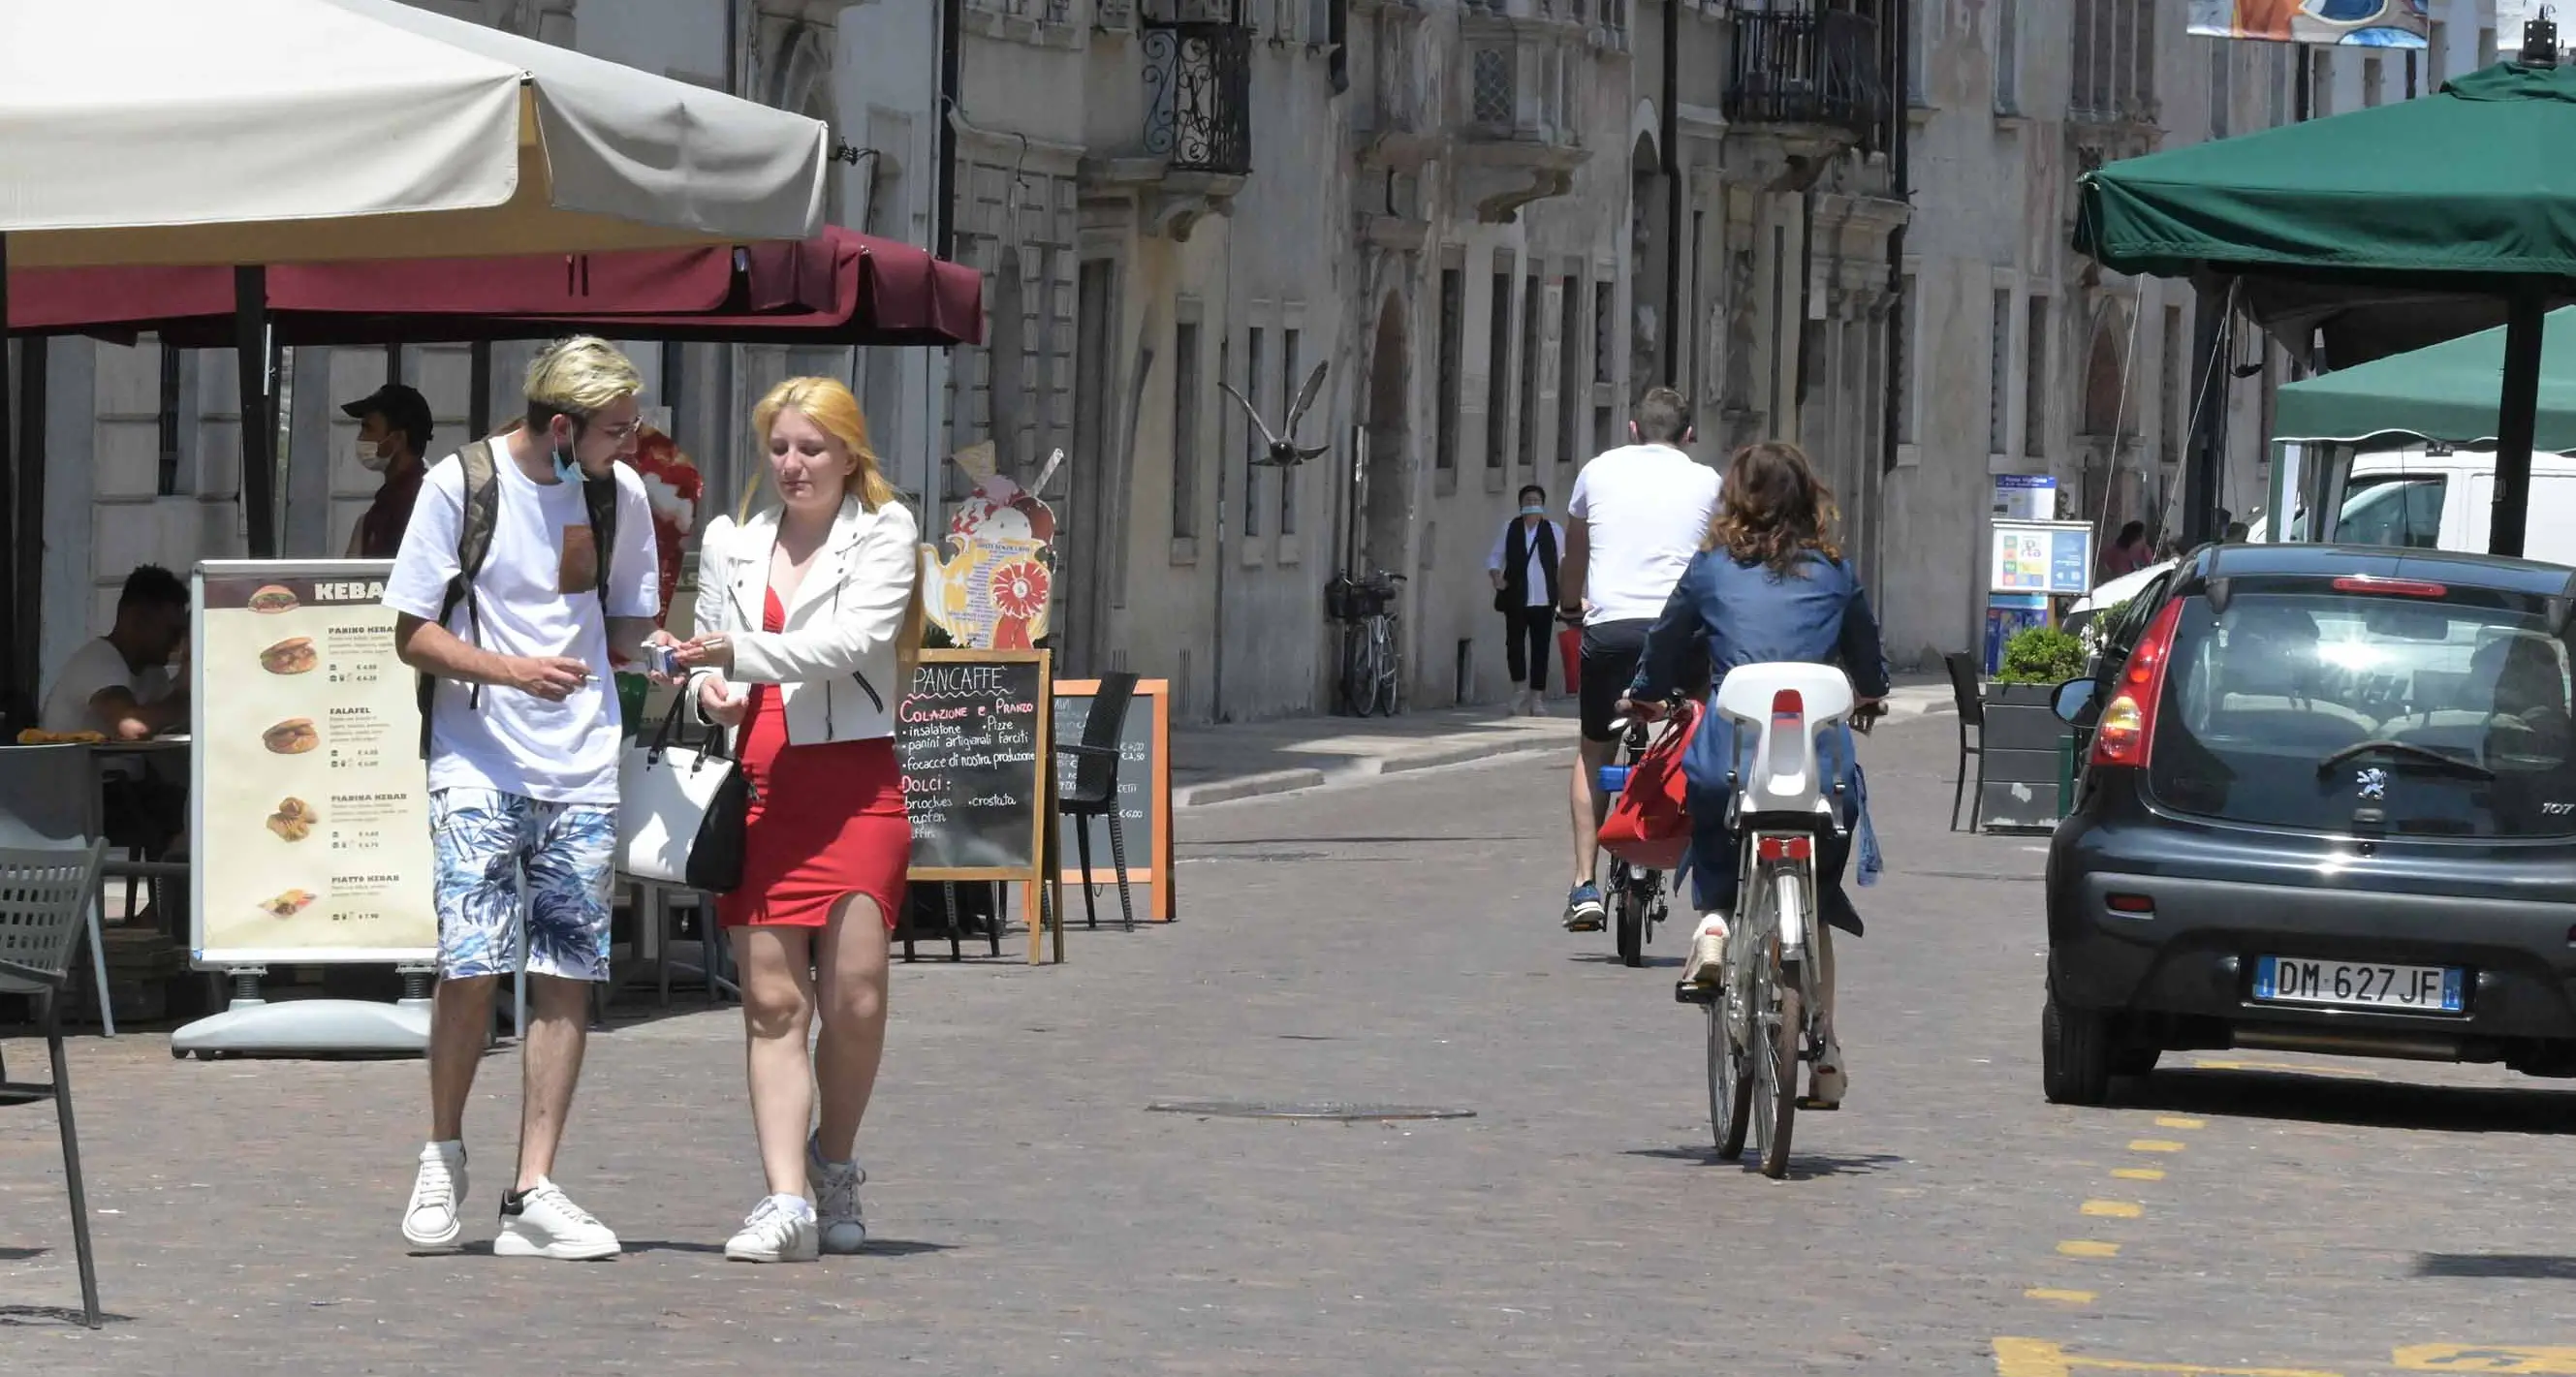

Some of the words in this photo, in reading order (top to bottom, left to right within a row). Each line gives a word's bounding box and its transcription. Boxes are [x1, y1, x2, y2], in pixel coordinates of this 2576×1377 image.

[315, 582, 385, 600] KEBA
[367, 625, 395, 634] KEBA
[900, 700, 968, 723] COLAZIONE
[977, 705, 987, 717] e
[995, 698, 1034, 715] PRANZO
[909, 723, 961, 736] insalatone
[908, 735, 940, 756] panini
[945, 734, 991, 751] artigianali
[949, 752, 959, 767] di
[960, 753, 992, 767] nostra
[992, 747, 1035, 770] produzione
[904, 795, 953, 810] brioches
[971, 793, 1017, 807] crostata
[2541, 802, 2575, 815] 107
[907, 808, 946, 829] rapfen
[331, 875, 364, 884] PIATTO
[2279, 962, 2320, 998] DM
[2334, 967, 2396, 1002] 627
[2399, 970, 2440, 1004] JF
